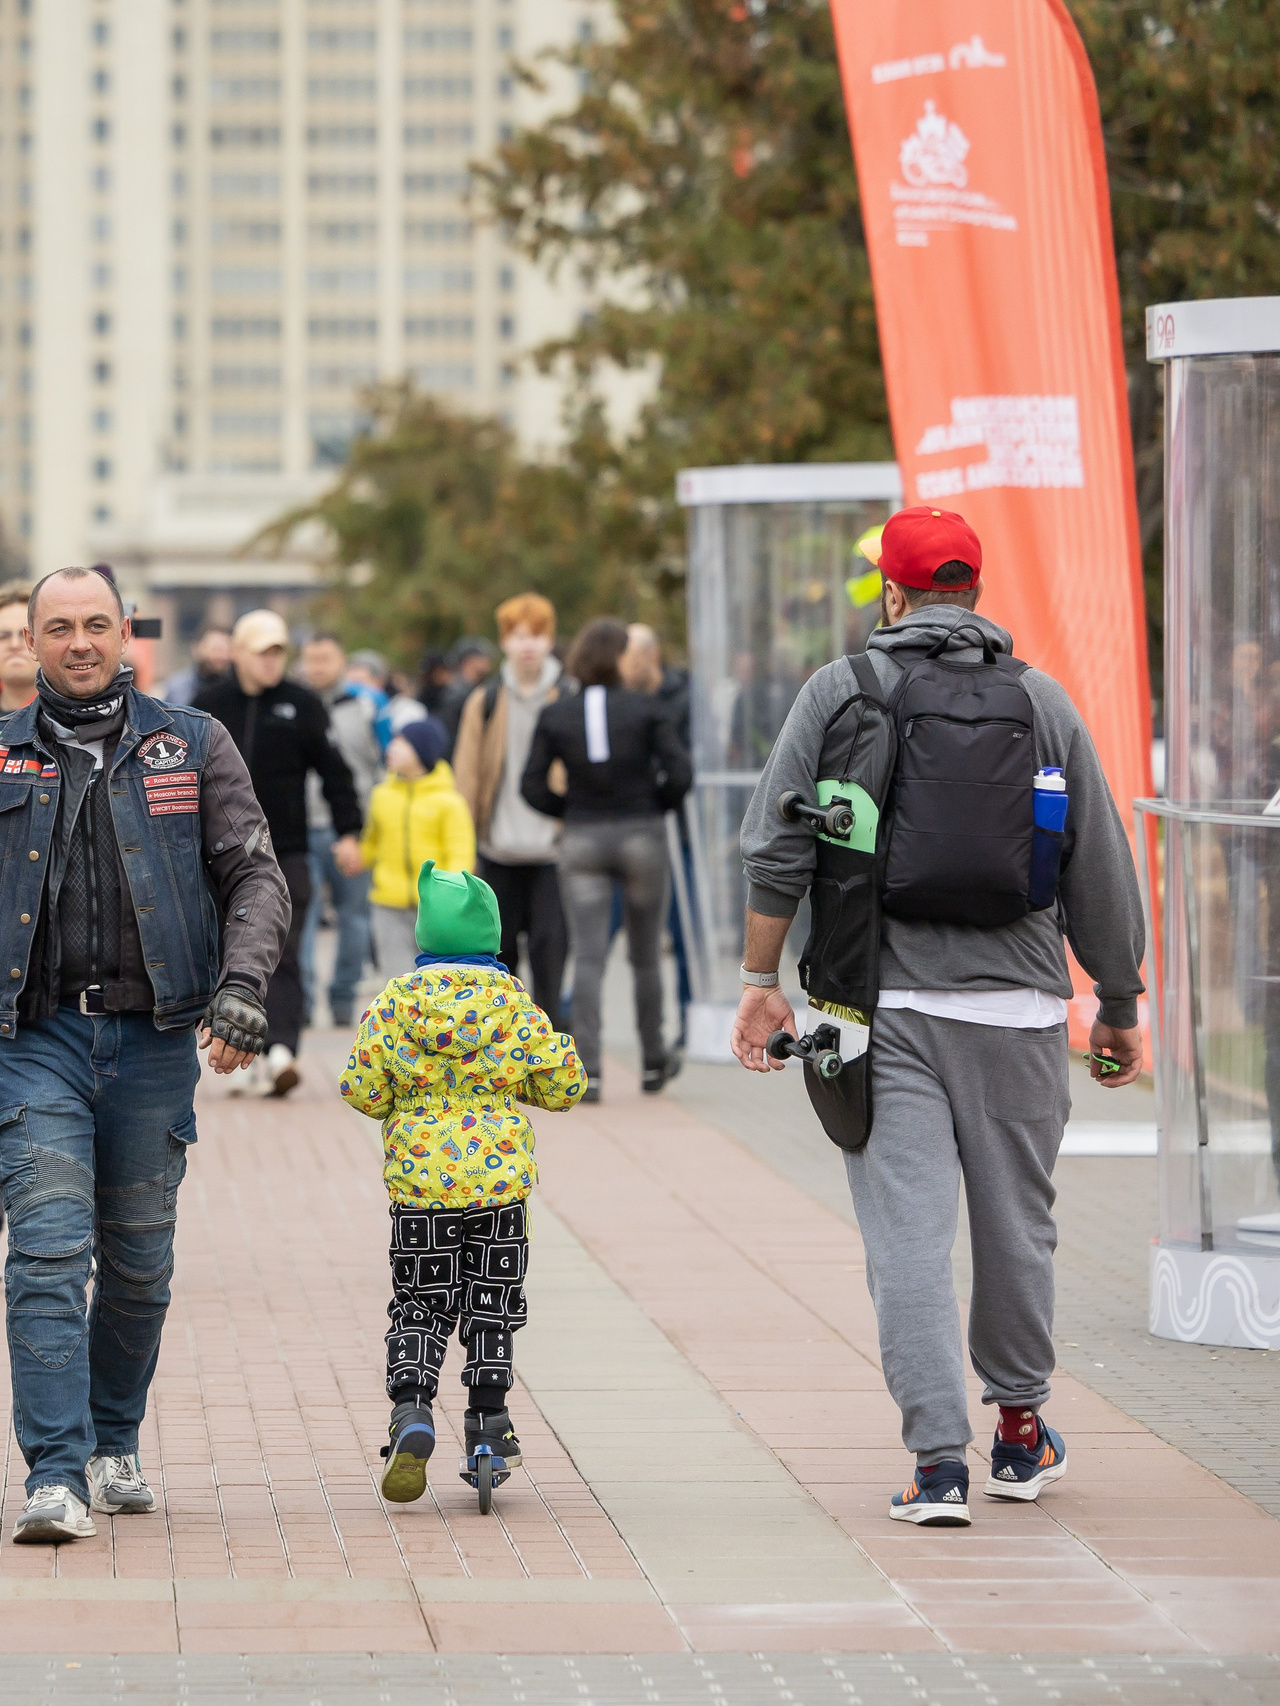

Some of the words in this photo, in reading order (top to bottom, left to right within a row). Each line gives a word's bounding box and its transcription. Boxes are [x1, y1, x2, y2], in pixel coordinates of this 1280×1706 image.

[143, 734, 179, 751] BOOMERANG
[155, 741, 170, 758] 1
[153, 776, 168, 784] Road
[464, 1167, 490, 1178] batik
[446, 1225, 456, 1237] C
[499, 1256, 509, 1269] G
[430, 1264, 440, 1276] Y
[480, 1292, 492, 1305] M
[398, 1349, 406, 1360] 6
[496, 1345, 505, 1358] 8
[997, 1472, 1018, 1480] adidas
